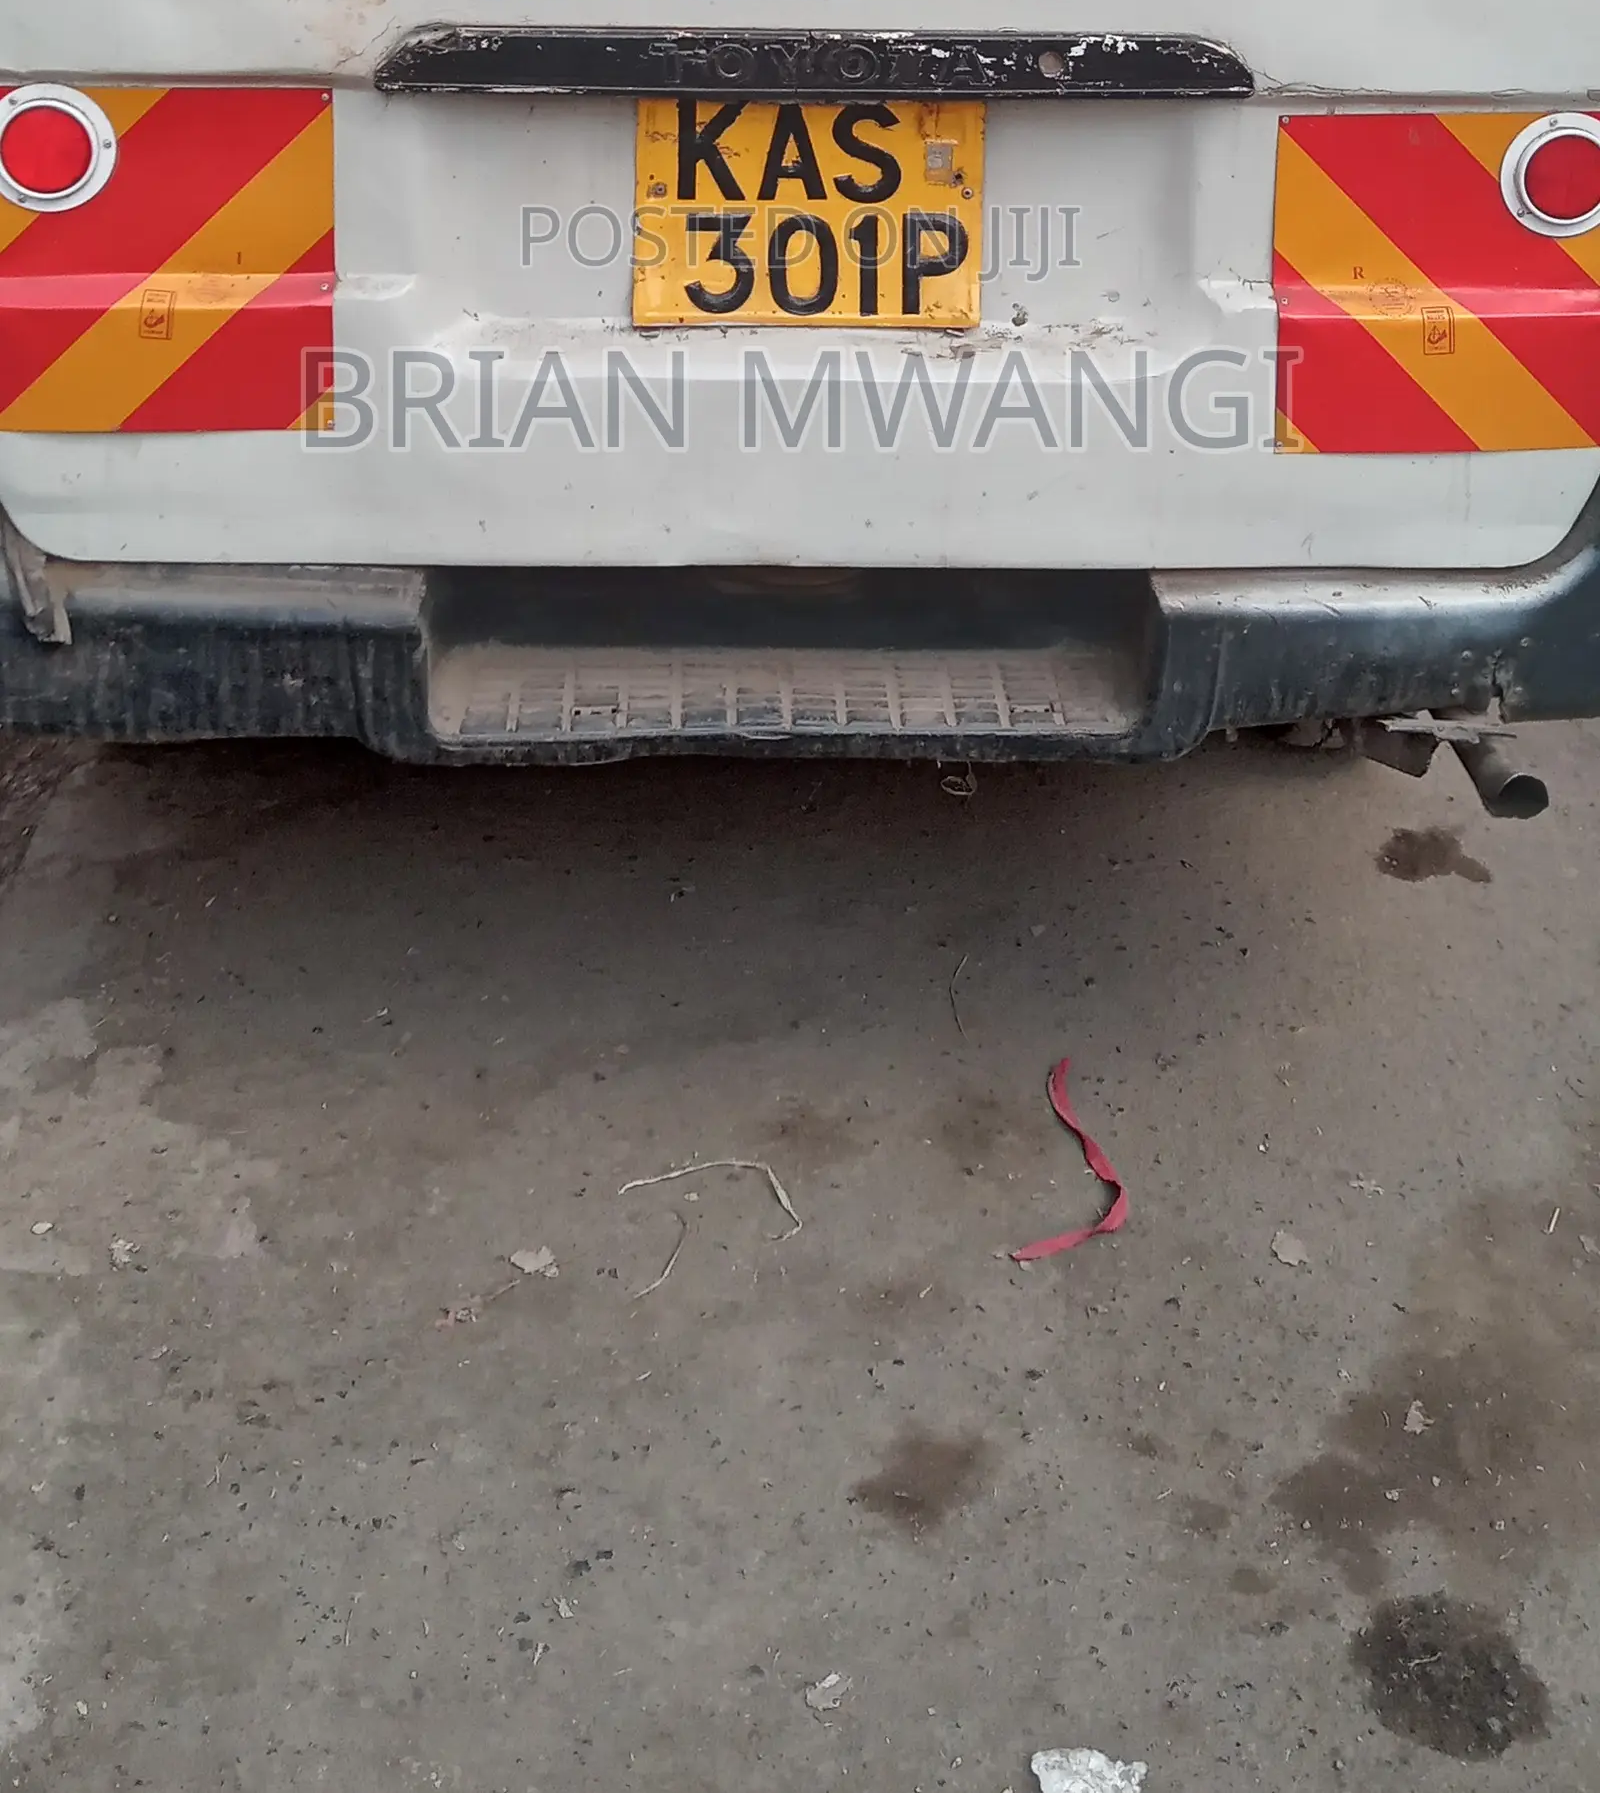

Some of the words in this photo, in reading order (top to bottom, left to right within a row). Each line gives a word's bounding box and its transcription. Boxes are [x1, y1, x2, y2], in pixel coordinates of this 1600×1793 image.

[648, 43, 998, 88] TOYOTA
[676, 98, 902, 203] KAS
[684, 212, 970, 317] 301P
[1353, 266, 1365, 280] R
